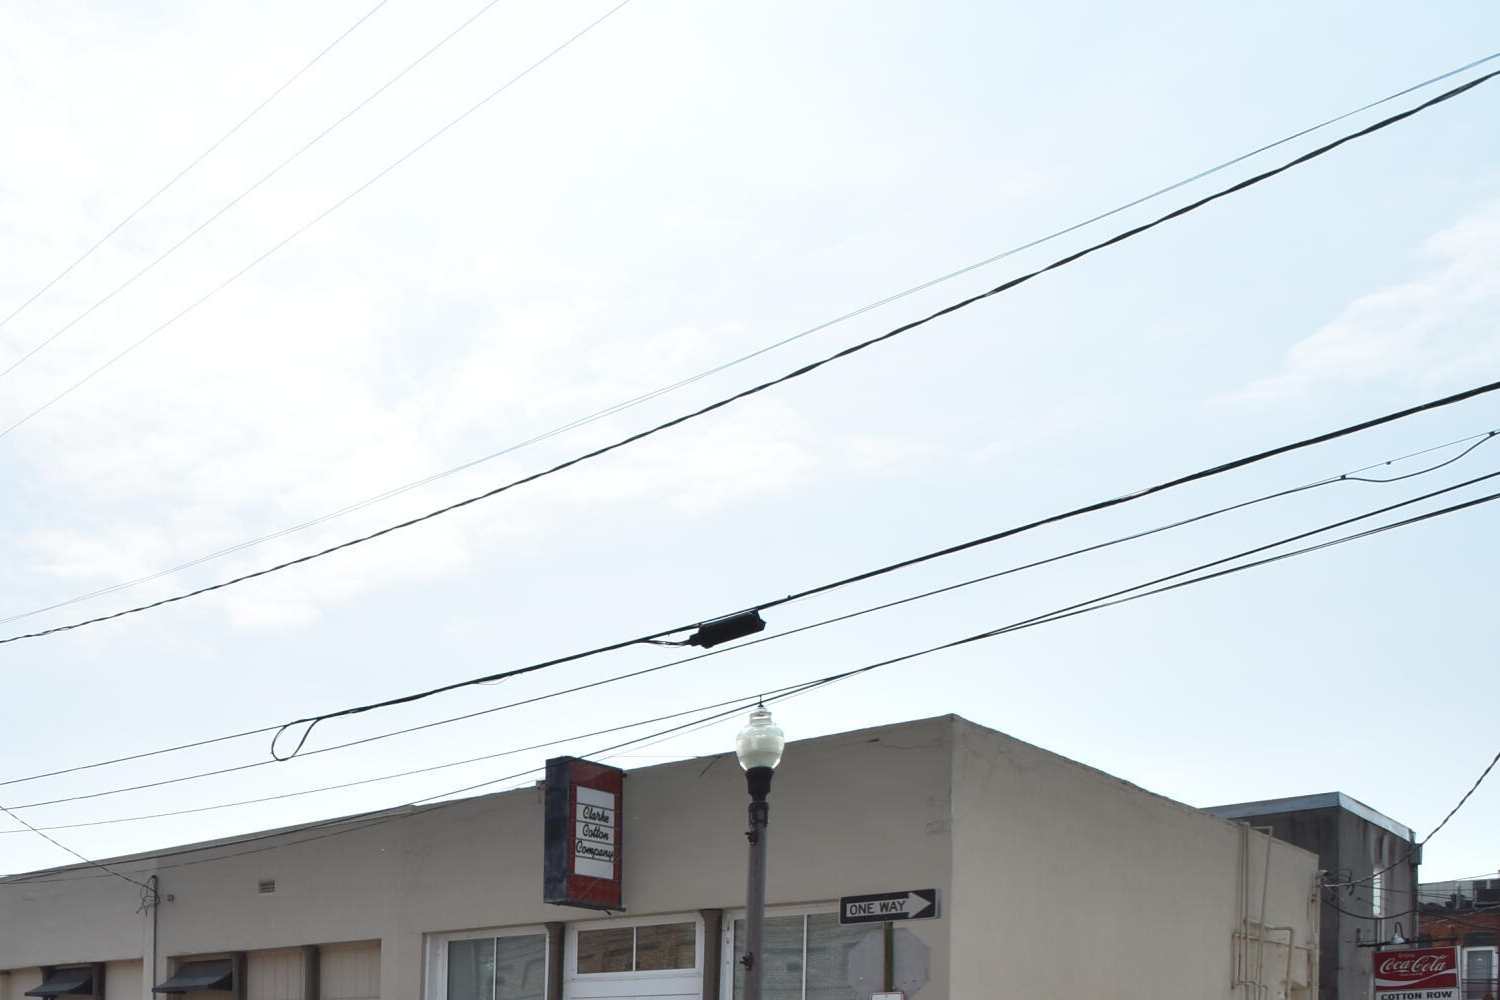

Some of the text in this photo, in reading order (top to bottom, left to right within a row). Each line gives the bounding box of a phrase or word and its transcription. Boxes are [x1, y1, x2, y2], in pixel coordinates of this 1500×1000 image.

[583, 807, 609, 823] Clarke
[583, 825, 609, 840] Cotton
[576, 841, 613, 861] Company
[850, 901, 905, 915] ONE WAY
[1380, 955, 1448, 974] Coca-Cola
[1381, 993, 1421, 1000] COTTON
